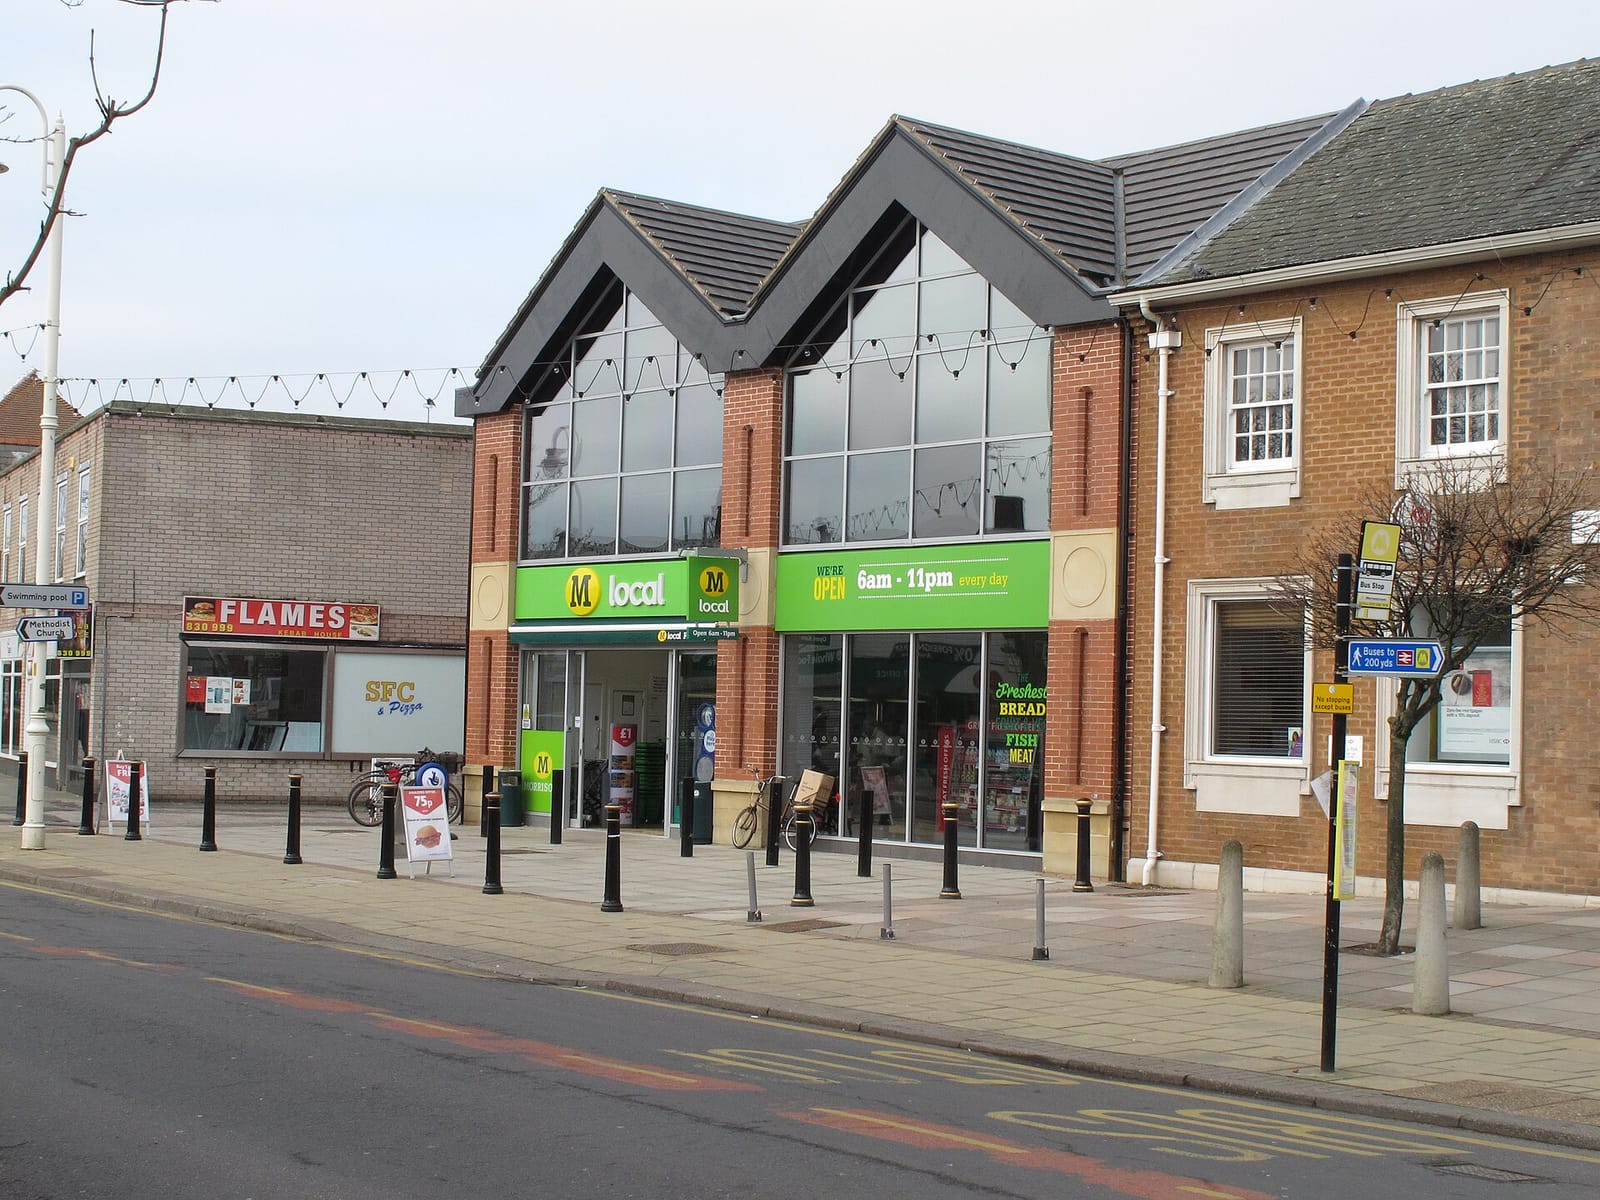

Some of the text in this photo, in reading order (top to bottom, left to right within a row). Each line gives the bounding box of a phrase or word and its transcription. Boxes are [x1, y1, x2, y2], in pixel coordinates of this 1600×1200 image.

[817, 565, 844, 576] WE'RE
[705, 571, 724, 593] M
[857, 569, 892, 590] 6am
[908, 568, 953, 592] 11pm
[959, 574, 986, 588] every
[989, 572, 1009, 587] day
[1372, 582, 1385, 590] Stop
[570, 572, 665, 608] M local
[813, 576, 846, 600] OPEN
[8, 592, 47, 602] Swimming
[699, 599, 730, 614] local
[220, 600, 345, 629] FLAMES
[29, 620, 70, 628] Methodist
[186, 622, 234, 633] 830 999
[36, 629, 66, 638] Church
[1363, 646, 1395, 656] Buses to
[1364, 658, 1393, 669] 200 yds
[365, 680, 415, 703] SFC
[377, 701, 424, 716] & Pizza
[1000, 702, 1046, 716] BREAD
[620, 728, 632, 739] £1
[1005, 733, 1038, 747] FISH
[1009, 748, 1034, 763] MEAT
[537, 755, 549, 774] M
[414, 795, 433, 809] 75p
